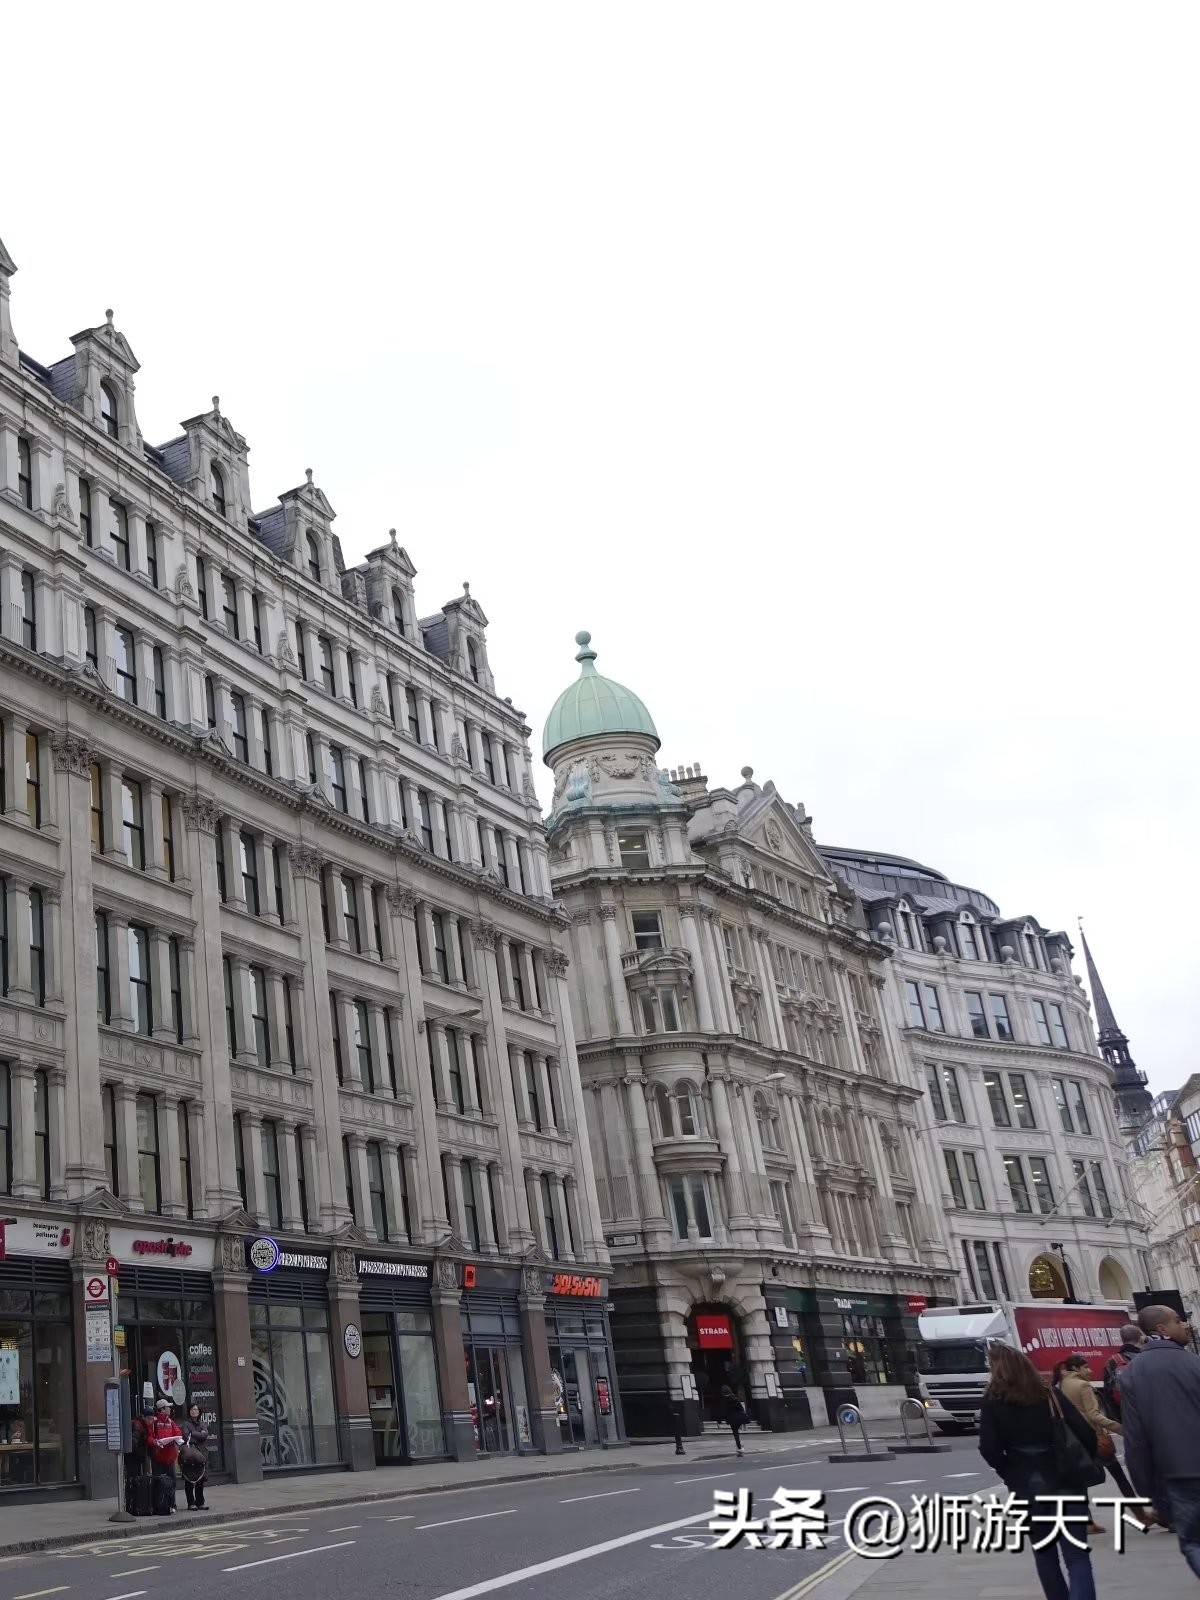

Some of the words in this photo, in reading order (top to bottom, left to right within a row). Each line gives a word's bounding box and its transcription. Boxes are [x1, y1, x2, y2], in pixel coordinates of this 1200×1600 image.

[108, 1262, 116, 1270] SJ
[699, 1327, 729, 1335] STRADA
[1041, 1328, 1060, 1347] WISH
[1073, 1328, 1086, 1347] ON
[189, 1343, 213, 1355] coffee
